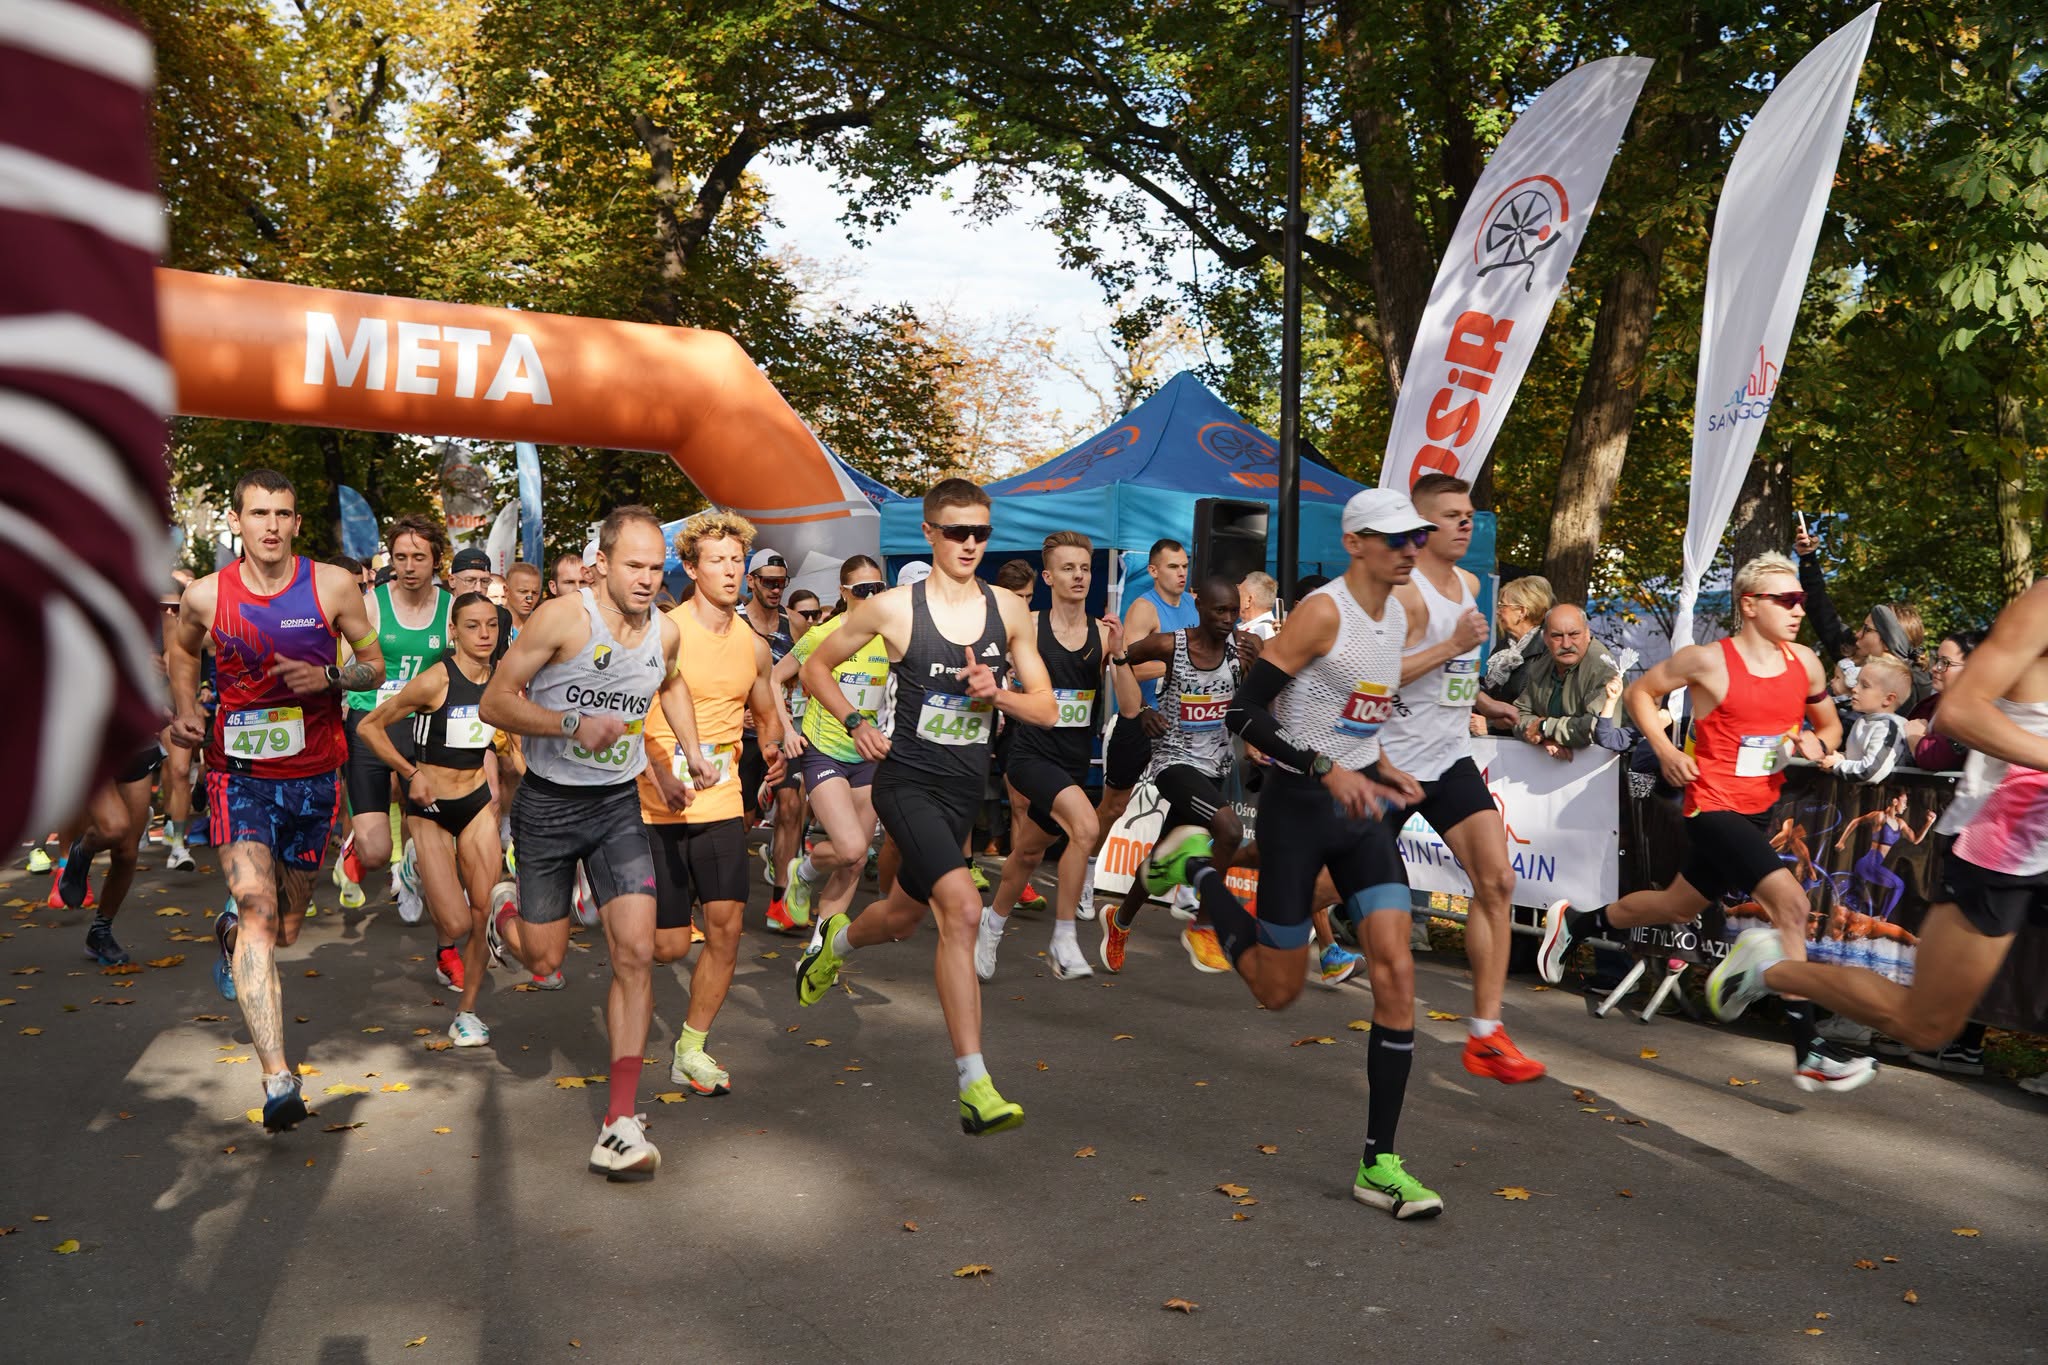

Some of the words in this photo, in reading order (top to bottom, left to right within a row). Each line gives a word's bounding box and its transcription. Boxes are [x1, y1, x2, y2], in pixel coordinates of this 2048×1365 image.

[303, 311, 553, 406] META
[280, 618, 316, 627] KONRAD
[398, 655, 423, 681] 57
[843, 674, 856, 684] 46.
[566, 684, 651, 715] GOSIEWS
[857, 688, 866, 706] 1
[928, 694, 946, 707] 46.
[227, 713, 244, 726] 46.
[451, 707, 466, 719] 46.
[1059, 704, 1087, 723] 90
[1185, 704, 1228, 721] 1045
[469, 721, 484, 743] 2
[924, 713, 982, 740] 448
[232, 727, 291, 755] 479
[1630, 926, 1649, 943] NIE
[1651, 928, 1698, 951] TYLKO
